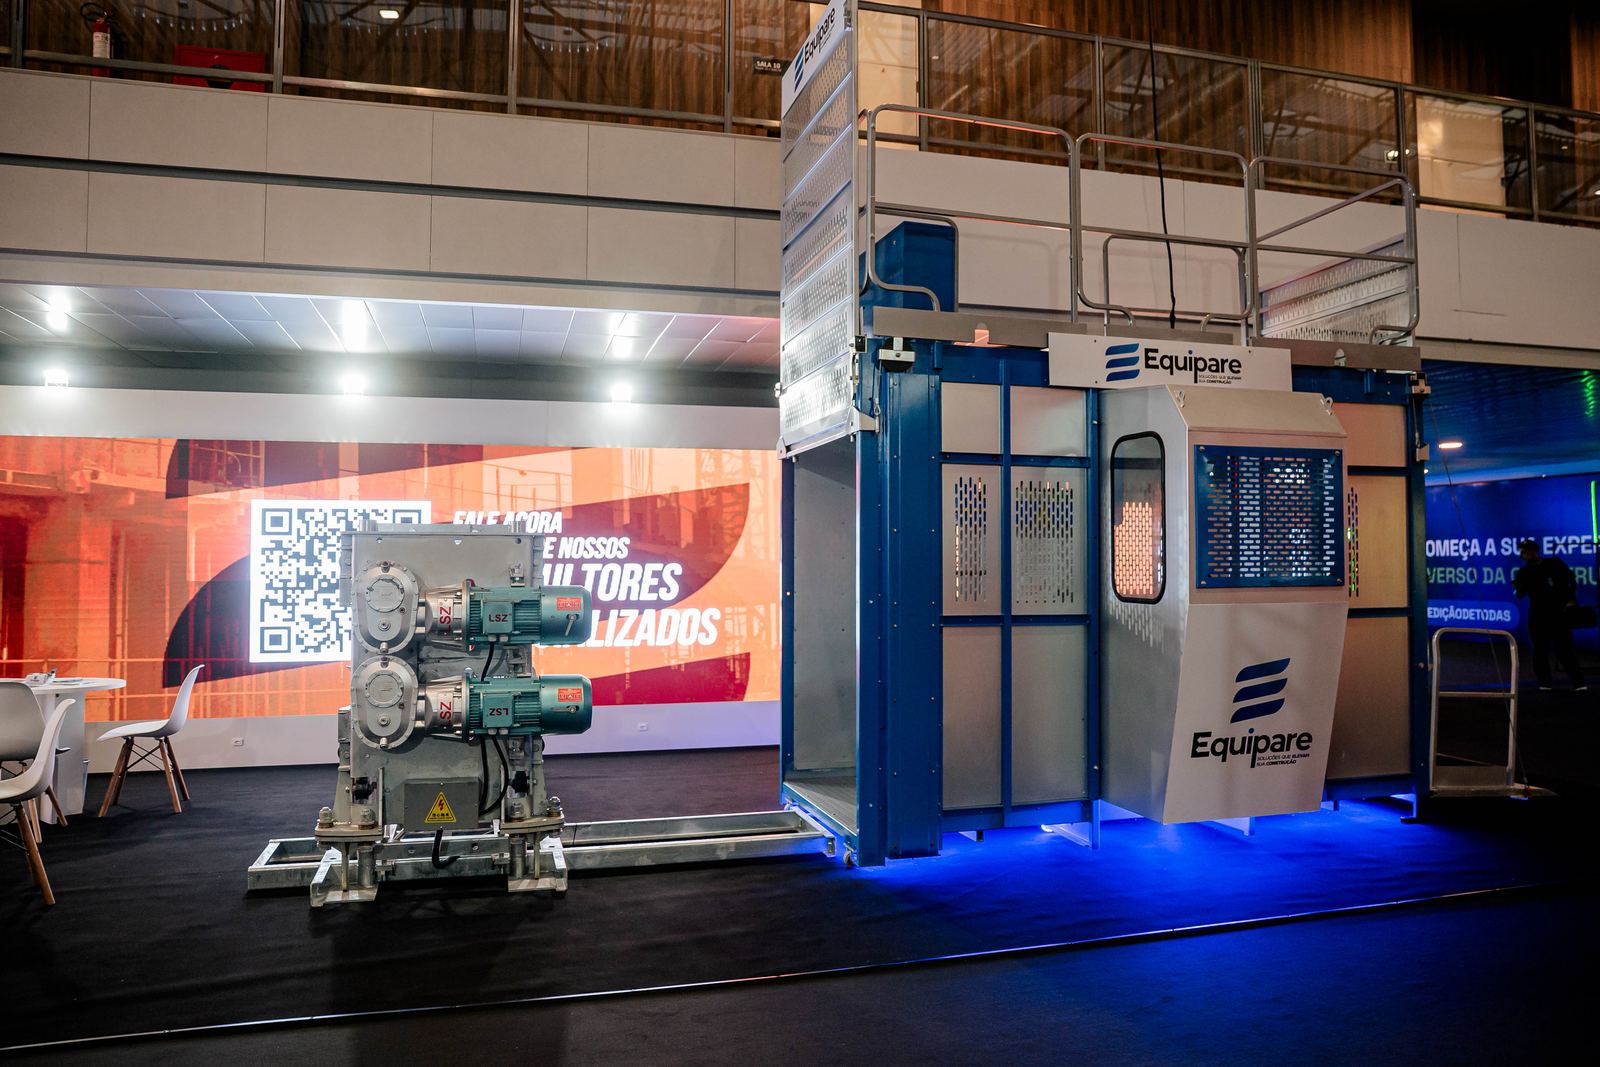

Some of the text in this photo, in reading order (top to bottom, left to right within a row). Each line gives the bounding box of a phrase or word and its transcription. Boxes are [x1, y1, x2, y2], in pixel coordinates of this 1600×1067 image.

[804, 8, 836, 64] Equipare
[1144, 347, 1242, 384] Equipare
[558, 536, 630, 559] NOSSOS
[1425, 538, 1481, 561] OMEÇA
[1485, 538, 1497, 556] A
[1500, 536, 1535, 556] SU
[543, 562, 683, 601] ULTORES
[1426, 567, 1477, 585] VERSO
[1483, 567, 1506, 585] DA
[440, 607, 452, 632] LSZ
[488, 614, 509, 623] LSZ
[489, 707, 509, 716] LSZ
[1191, 727, 1313, 768] Equipare
